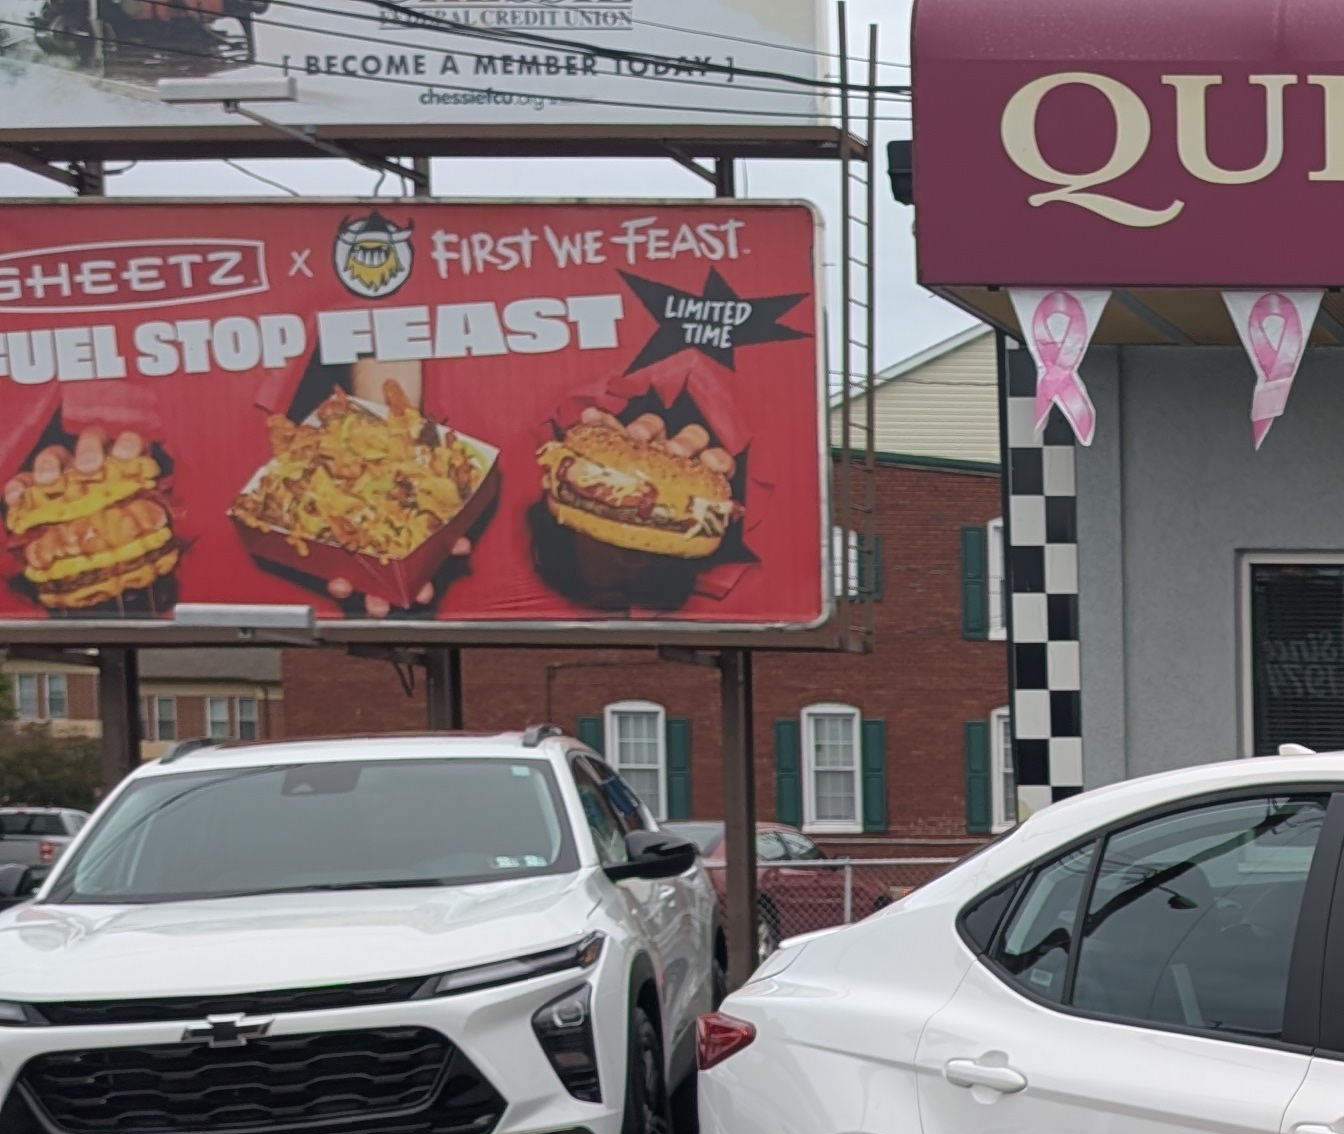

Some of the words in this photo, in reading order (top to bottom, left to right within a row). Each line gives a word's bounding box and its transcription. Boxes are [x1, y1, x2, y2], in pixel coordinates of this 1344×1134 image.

[480, 9, 564, 27] CREDIT
[565, 9, 633, 27] UNION
[305, 54, 427, 76] BECOME
[440, 54, 459, 75] A
[474, 54, 598, 76] MEMBER
[430, 228, 538, 280] FIRST
[543, 225, 607, 269] WE
[610, 216, 746, 265] FEAST
[664, 295, 753, 326] LIMITED
[0, 325, 128, 385] UEL
[133, 313, 307, 377] STOP
[317, 293, 625, 367] FEAST
[681, 322, 733, 349] TIME
